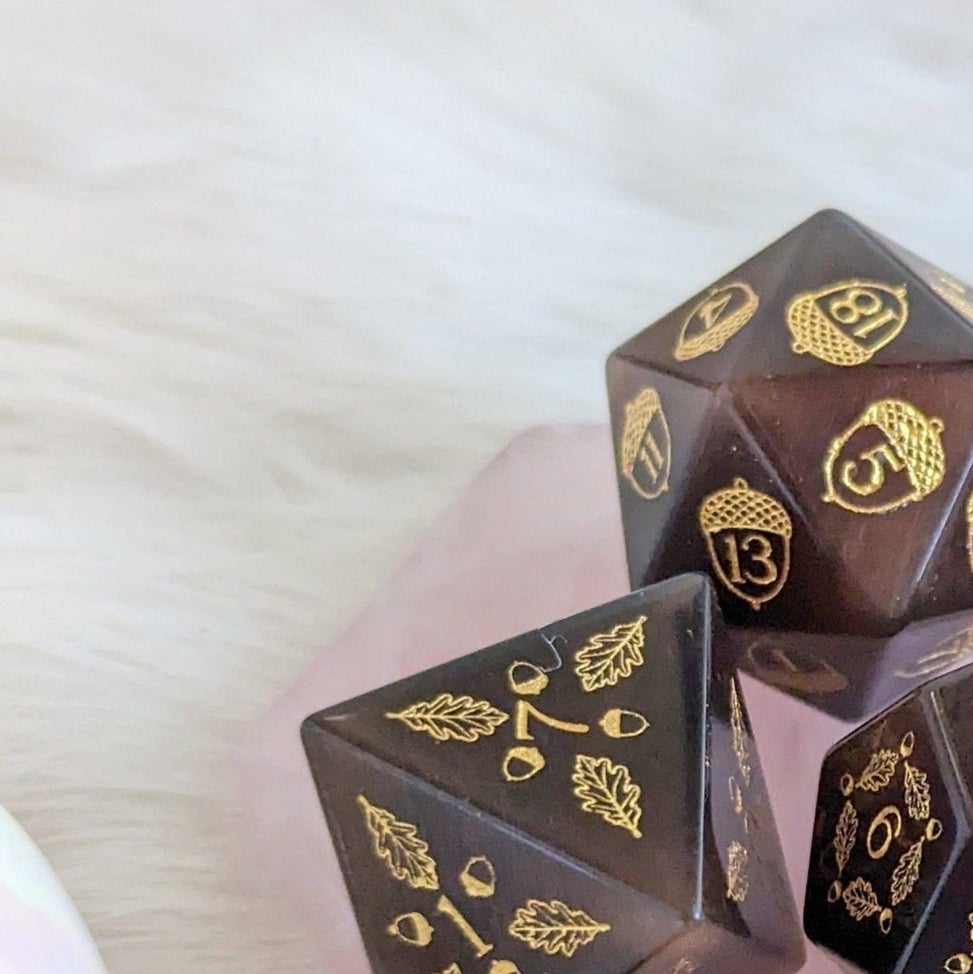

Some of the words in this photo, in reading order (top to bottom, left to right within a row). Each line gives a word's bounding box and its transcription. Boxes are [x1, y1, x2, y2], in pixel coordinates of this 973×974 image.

[700, 293, 732, 329] 4
[831, 287, 900, 338] 18
[641, 432, 665, 484] 11
[842, 443, 901, 496] 5
[723, 534, 778, 586] 13
[515, 700, 589, 740] 7
[437, 895, 494, 957] 1
